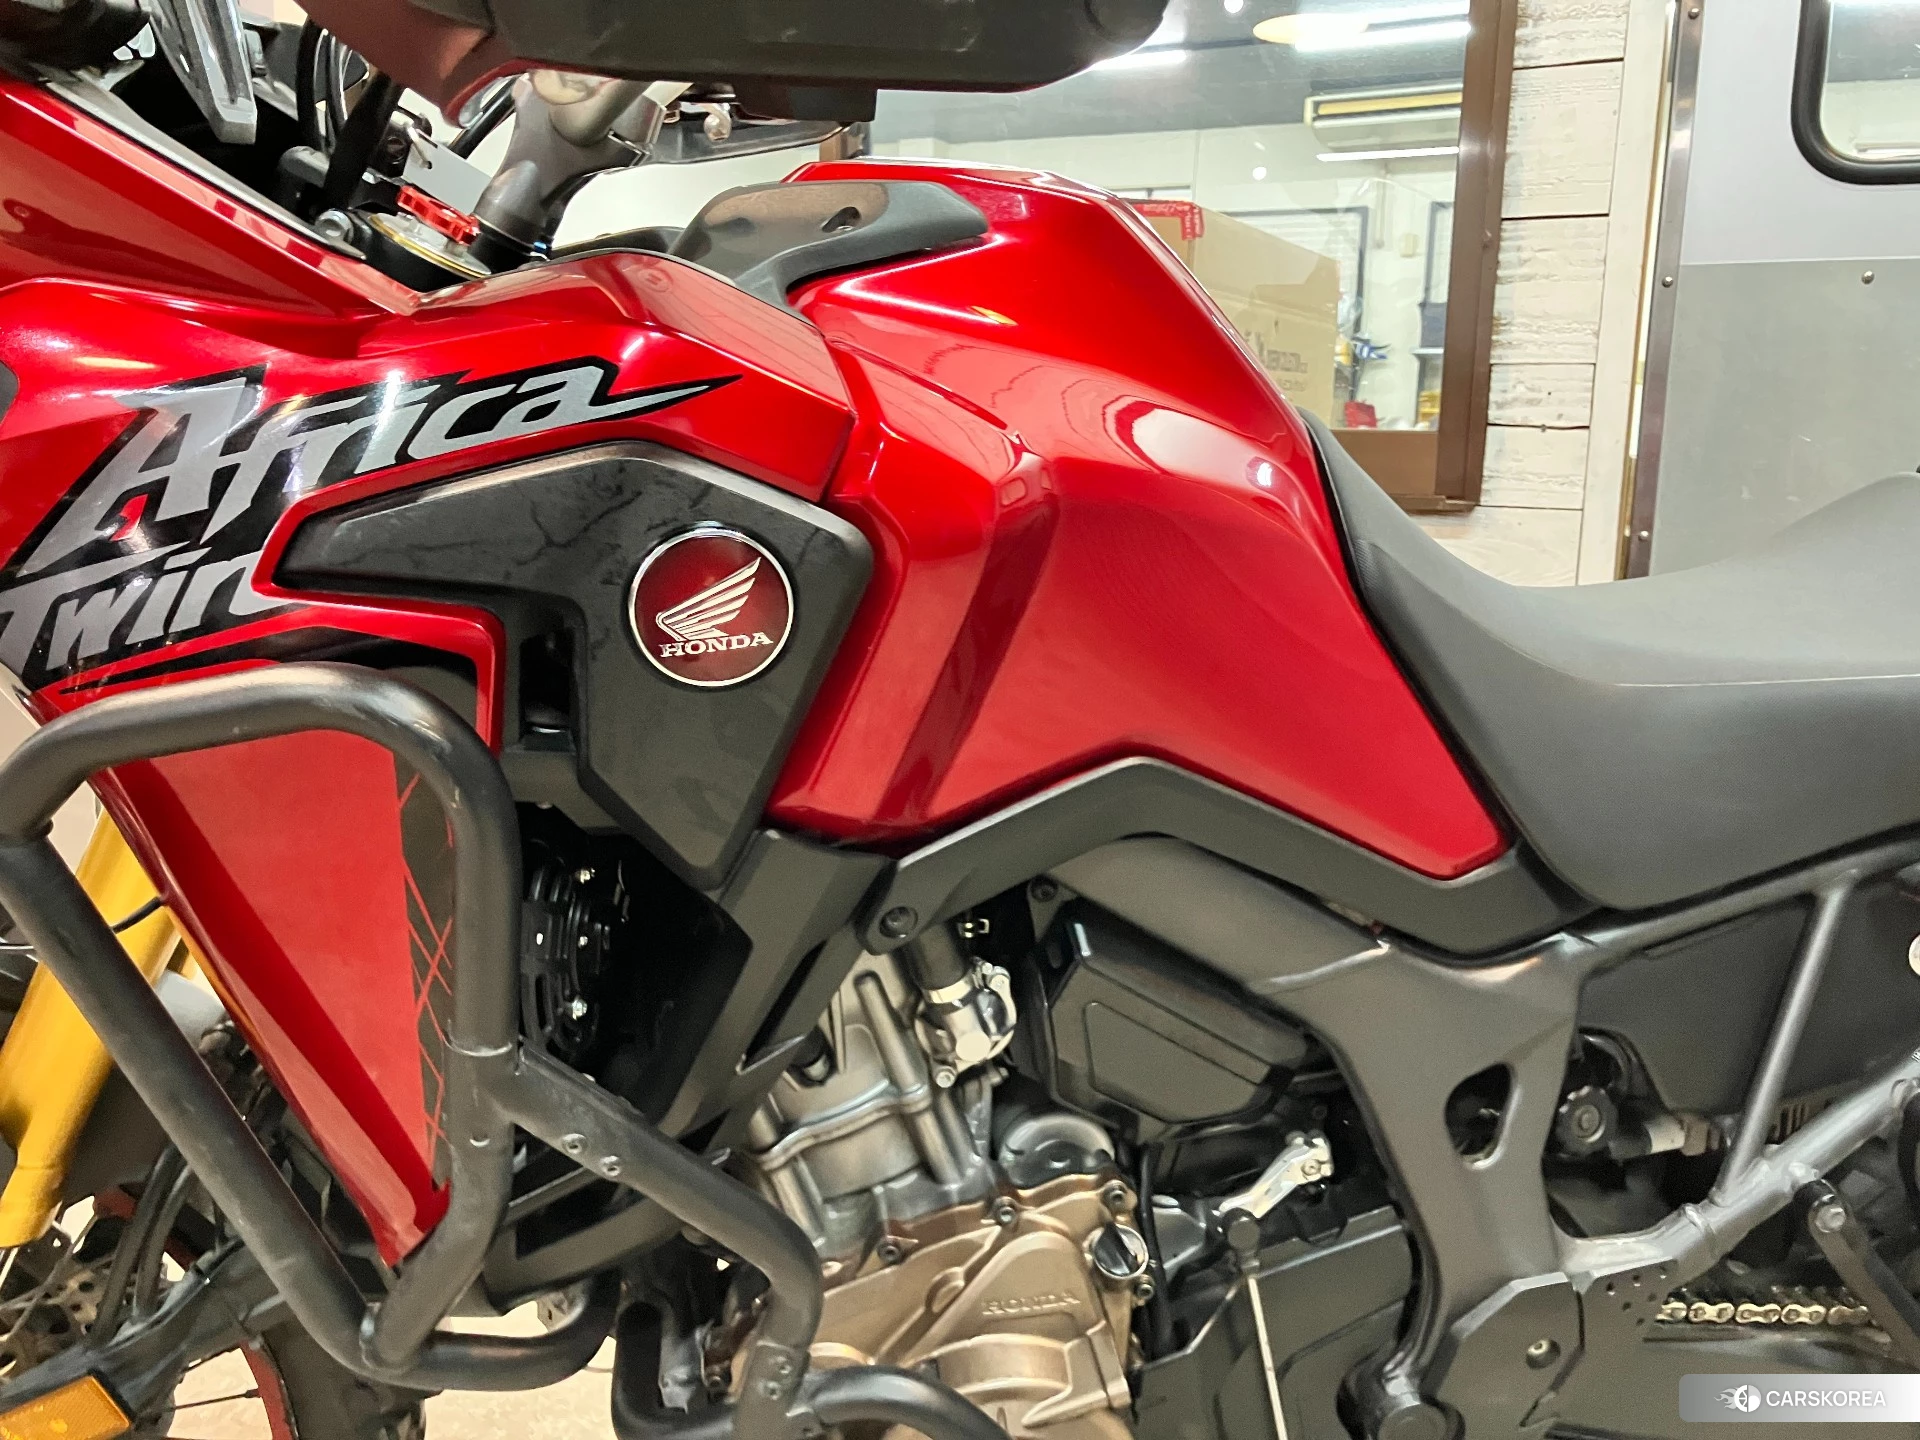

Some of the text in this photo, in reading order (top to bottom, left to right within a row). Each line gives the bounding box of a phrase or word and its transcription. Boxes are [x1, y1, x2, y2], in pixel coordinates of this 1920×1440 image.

[12, 362, 722, 578] Africa
[0, 541, 290, 676] Twin
[658, 631, 774, 658] HONDA
[981, 1291, 1081, 1316] HONDA
